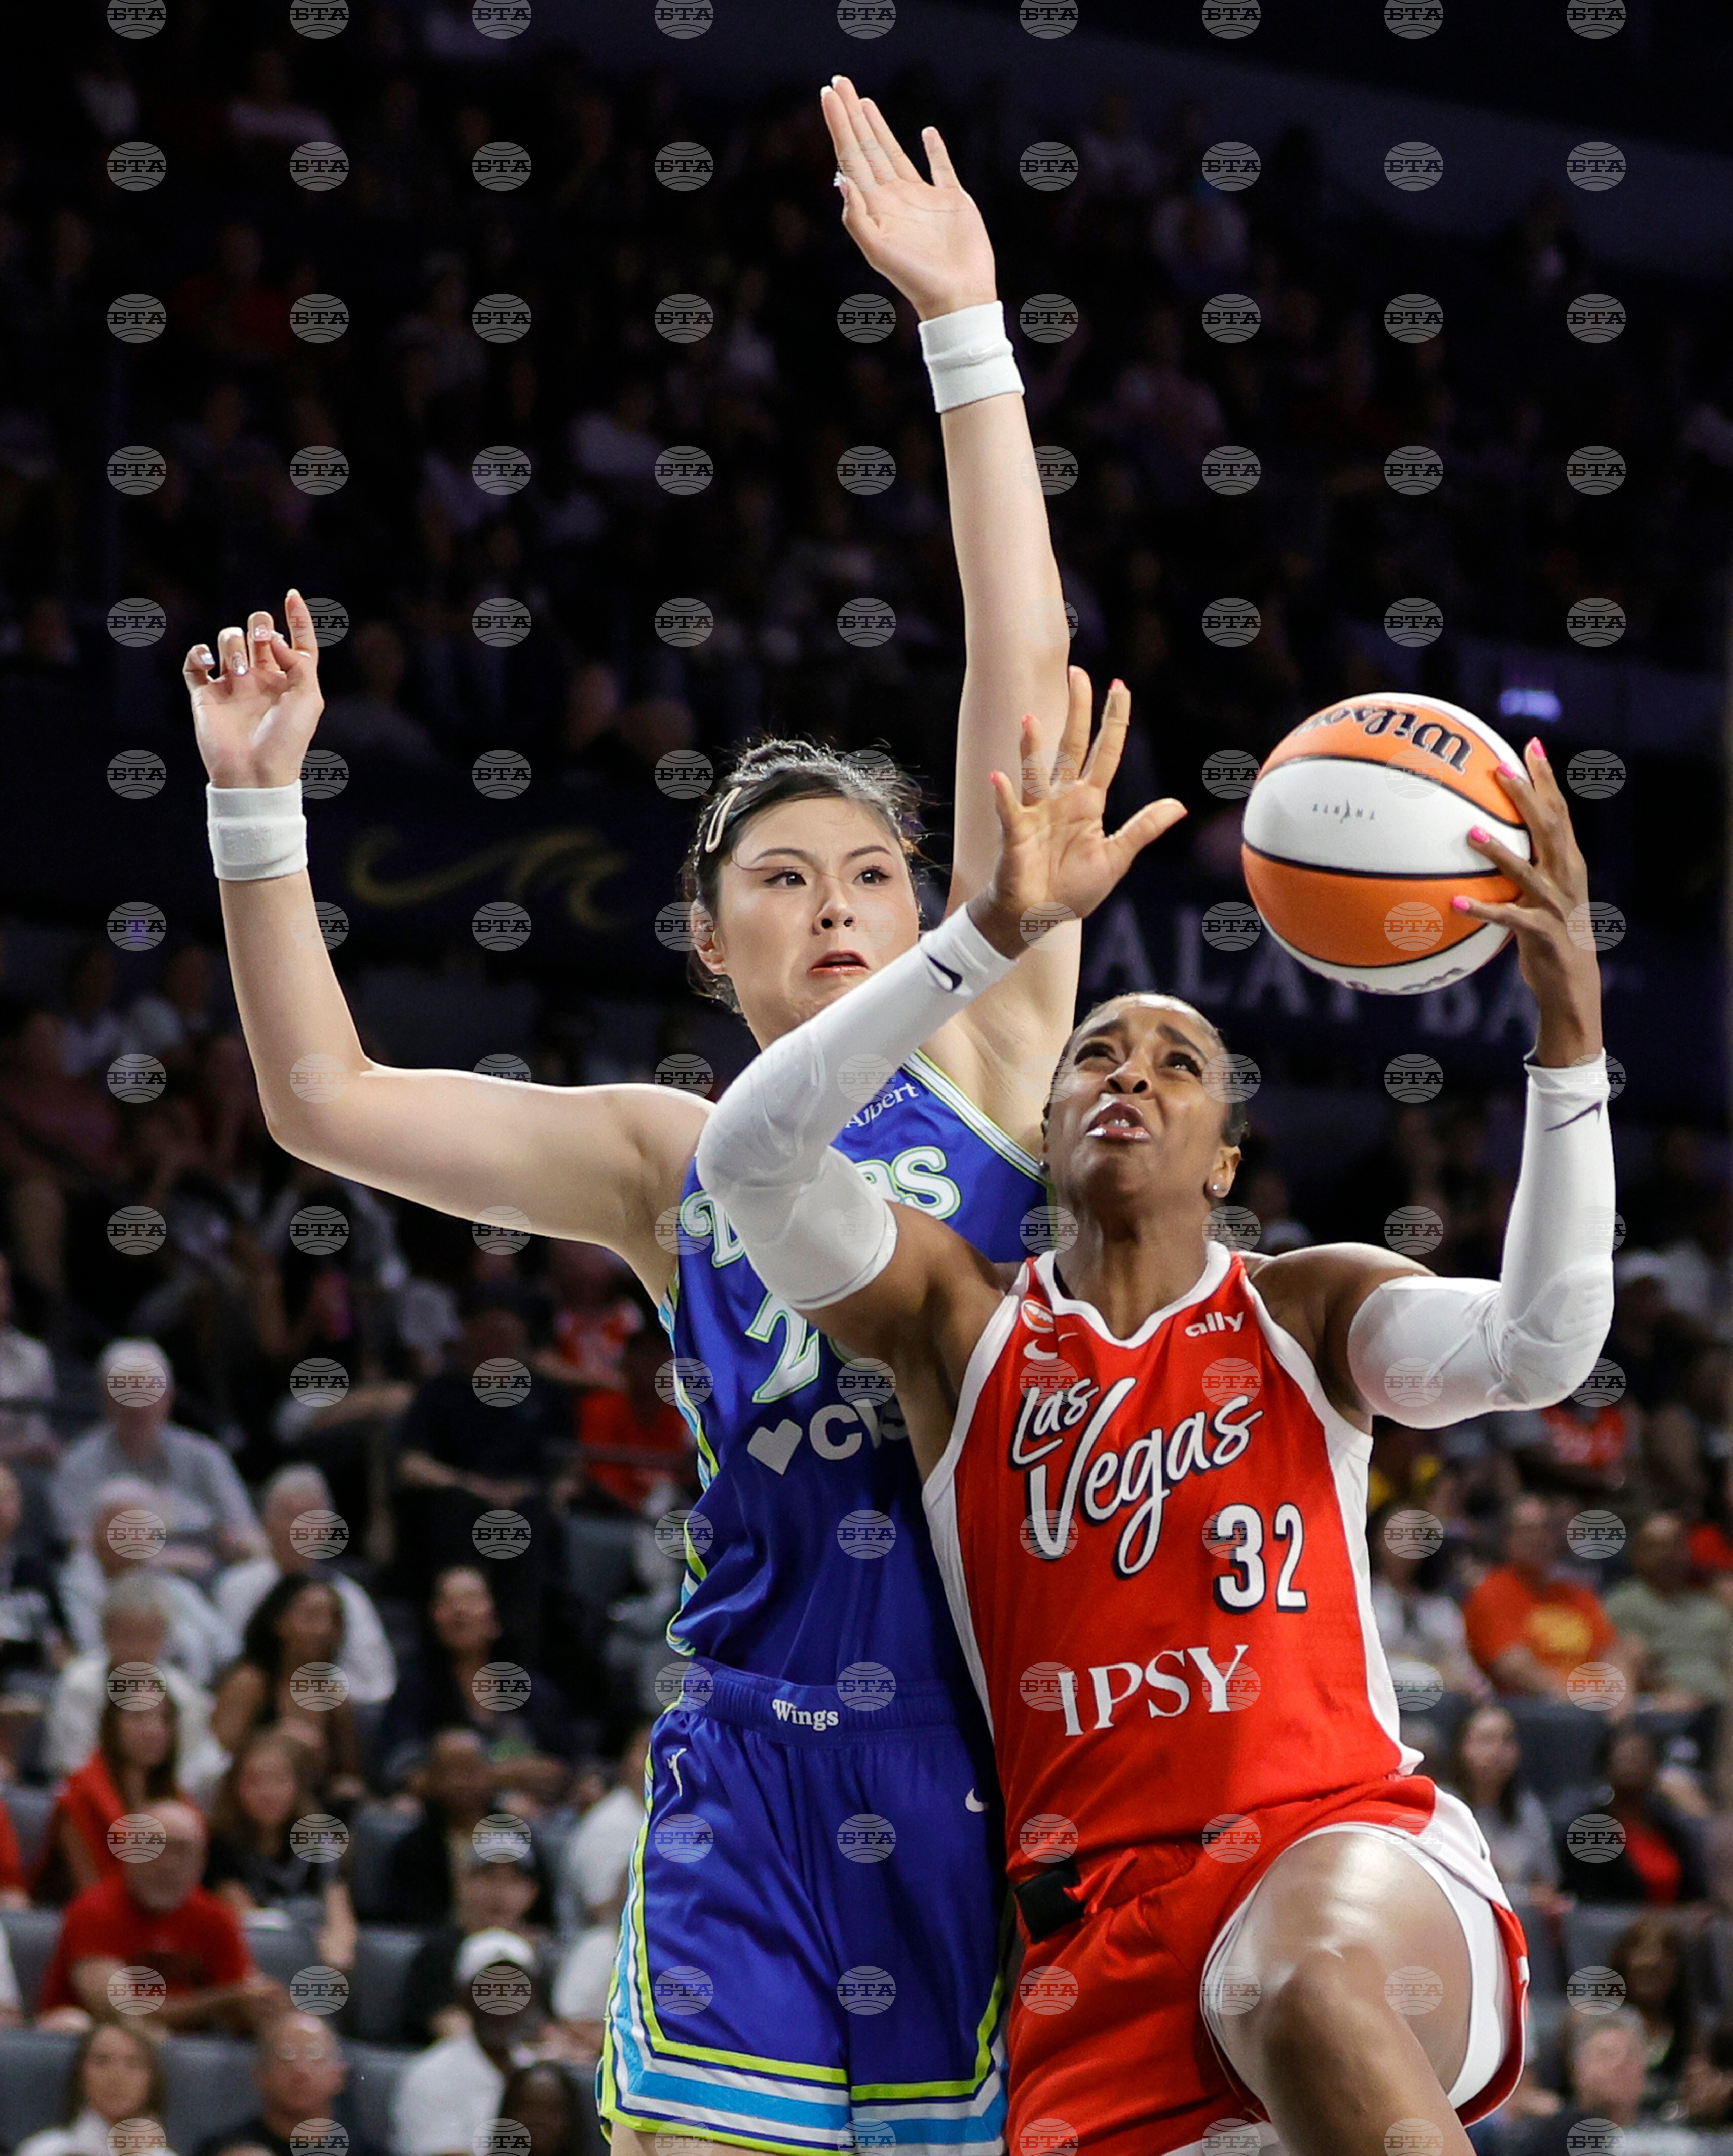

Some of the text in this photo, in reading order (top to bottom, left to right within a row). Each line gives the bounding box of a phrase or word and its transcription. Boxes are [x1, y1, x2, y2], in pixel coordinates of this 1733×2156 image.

[845, 1082, 919, 1128] Albert
[1184, 1311, 1245, 1338] ally
[1011, 1376, 1100, 1467] Las
[1027, 1376, 1264, 1577] Vegas
[1215, 1502, 1308, 1613] 32
[772, 1698, 840, 1732] Wings
[1056, 1643, 1249, 1738] IPSY
